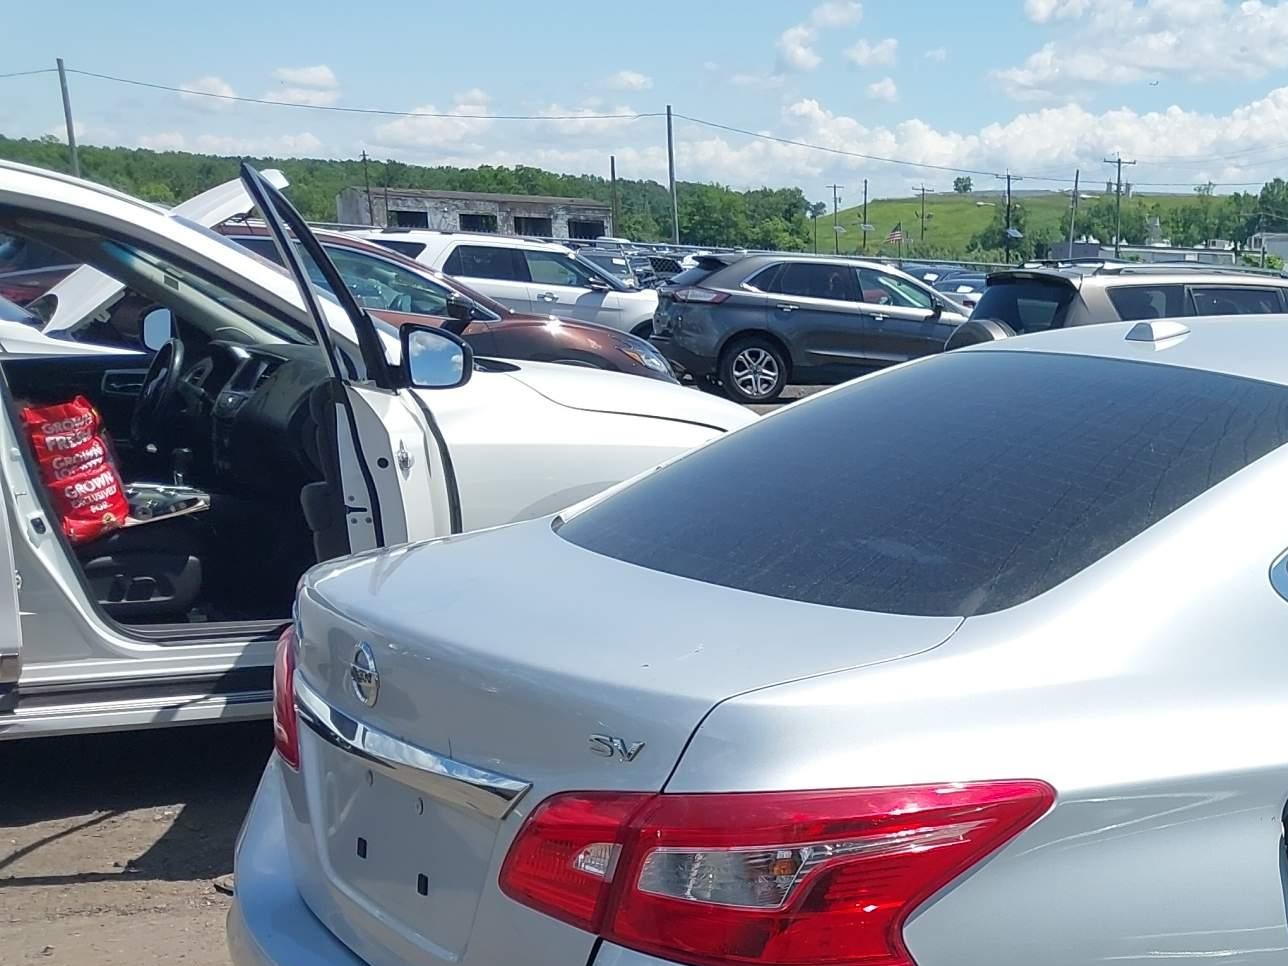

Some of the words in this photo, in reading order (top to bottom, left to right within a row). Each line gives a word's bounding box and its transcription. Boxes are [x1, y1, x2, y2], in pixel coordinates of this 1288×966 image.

[44, 428, 93, 452] FRESH
[64, 471, 115, 499] GROWN
[588, 733, 647, 762] SV
